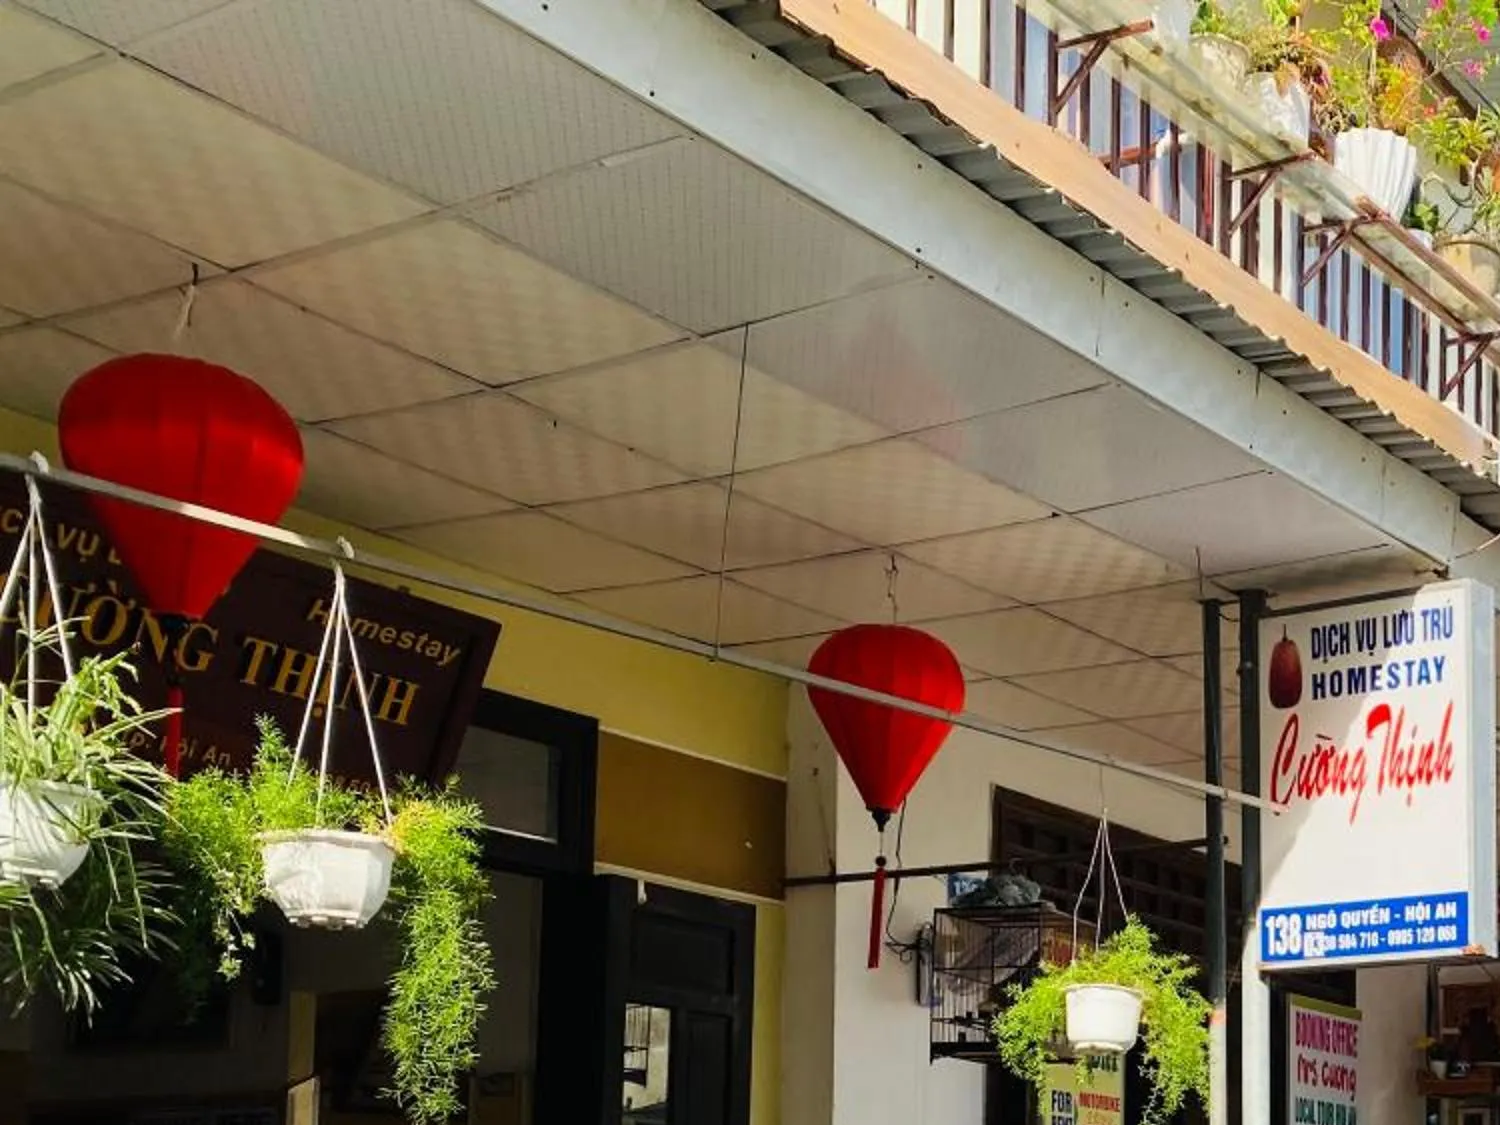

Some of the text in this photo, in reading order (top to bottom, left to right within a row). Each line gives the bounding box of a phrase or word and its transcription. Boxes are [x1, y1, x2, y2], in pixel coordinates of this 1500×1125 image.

[306, 600, 461, 667] Hmestay
[1311, 621, 1350, 663] DỊCH
[1355, 617, 1377, 656] VỤ
[1383, 609, 1415, 648] LƯU
[1312, 656, 1445, 700] HOMESTAY
[1366, 700, 1454, 807] Thịnh
[1266, 913, 1301, 956] 138
[1306, 908, 1336, 931] NGÔ
[1405, 899, 1431, 925] HỘI
[1435, 902, 1457, 921] AN
[1051, 1089, 1072, 1112] FOR
